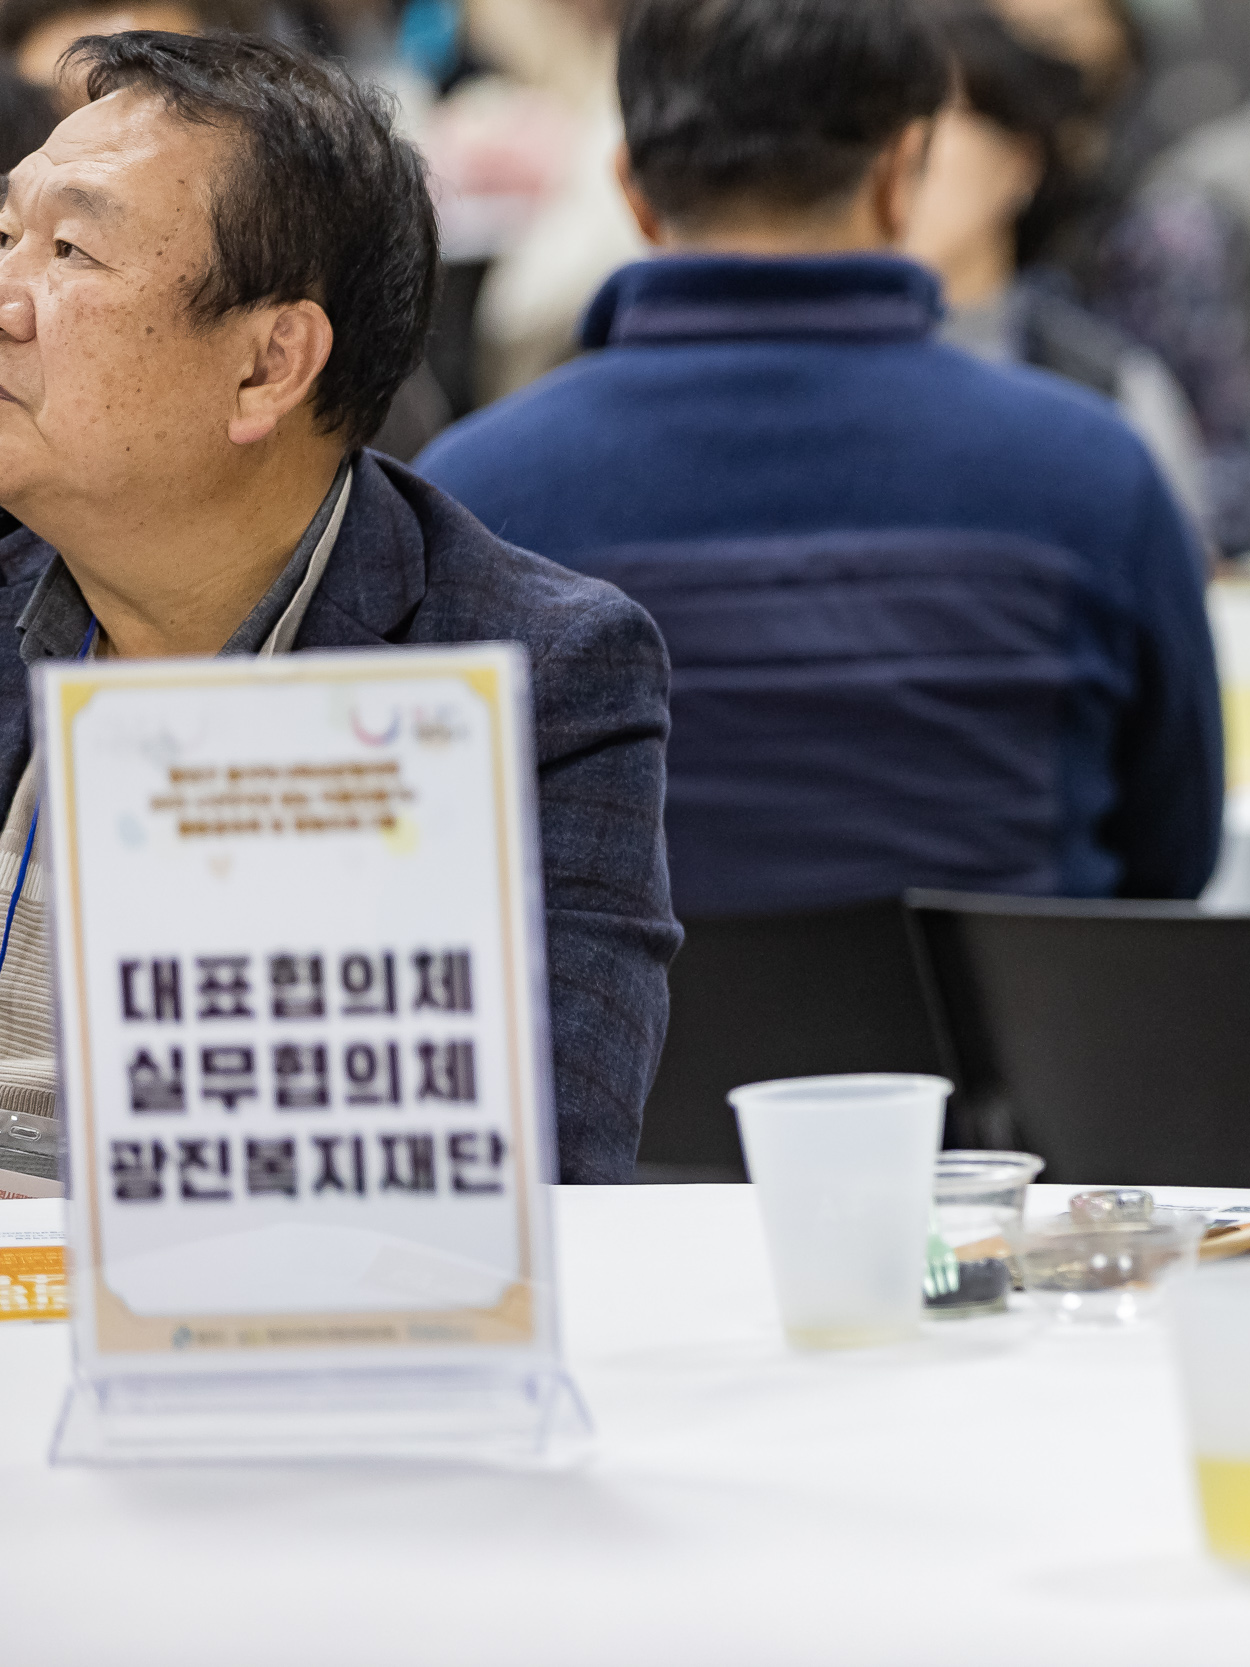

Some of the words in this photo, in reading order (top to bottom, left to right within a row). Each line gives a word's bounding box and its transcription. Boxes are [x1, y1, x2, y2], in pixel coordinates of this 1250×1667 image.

[118, 950, 474, 1022] 대표협의체
[128, 1039, 477, 1113] 실무협의체
[110, 1131, 506, 1202] 광진복지재단
